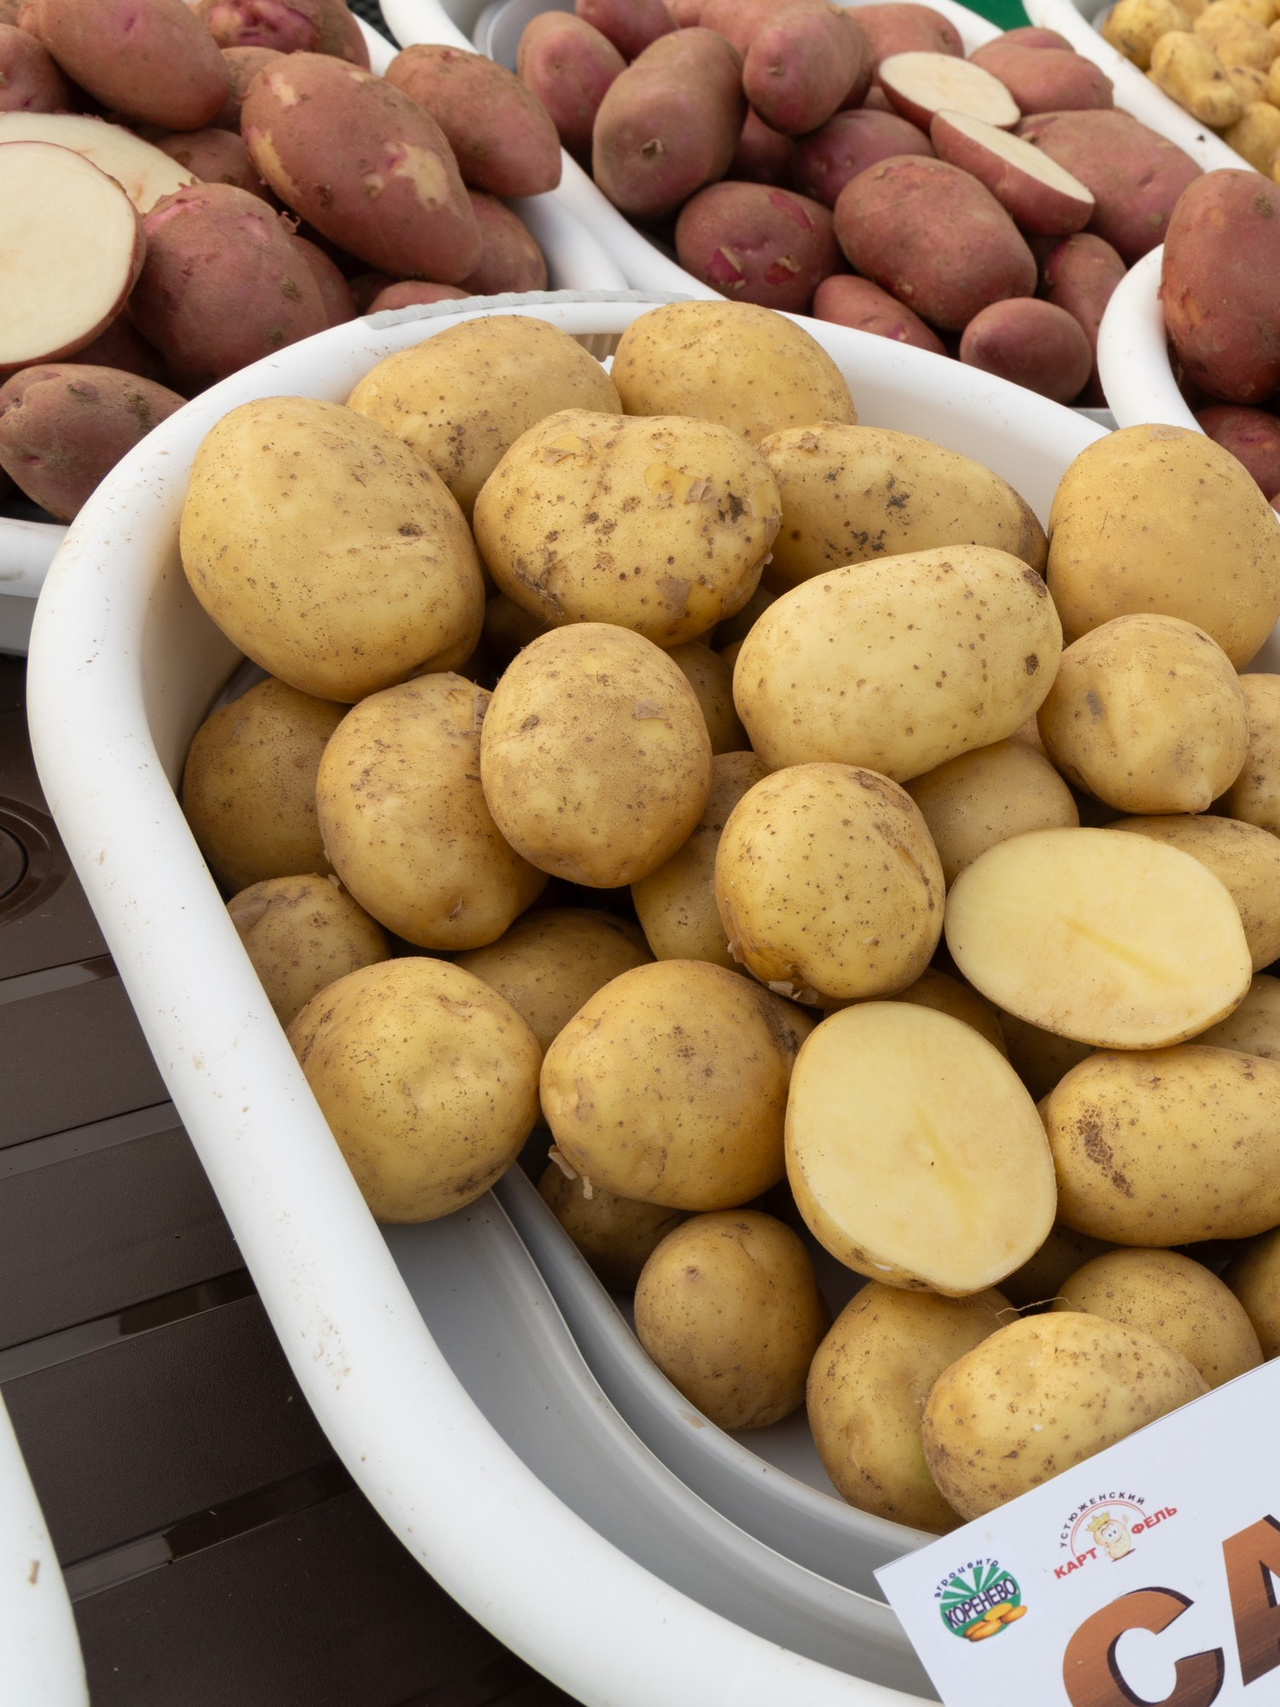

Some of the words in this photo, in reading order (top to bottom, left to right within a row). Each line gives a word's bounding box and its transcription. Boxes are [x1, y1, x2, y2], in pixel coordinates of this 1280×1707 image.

[1060, 1491, 1145, 1548] УСТЮЖЕНСКИЙ
[934, 1558, 999, 1599] агроцентр
[944, 1577, 1017, 1629] КОРЕНЕВО
